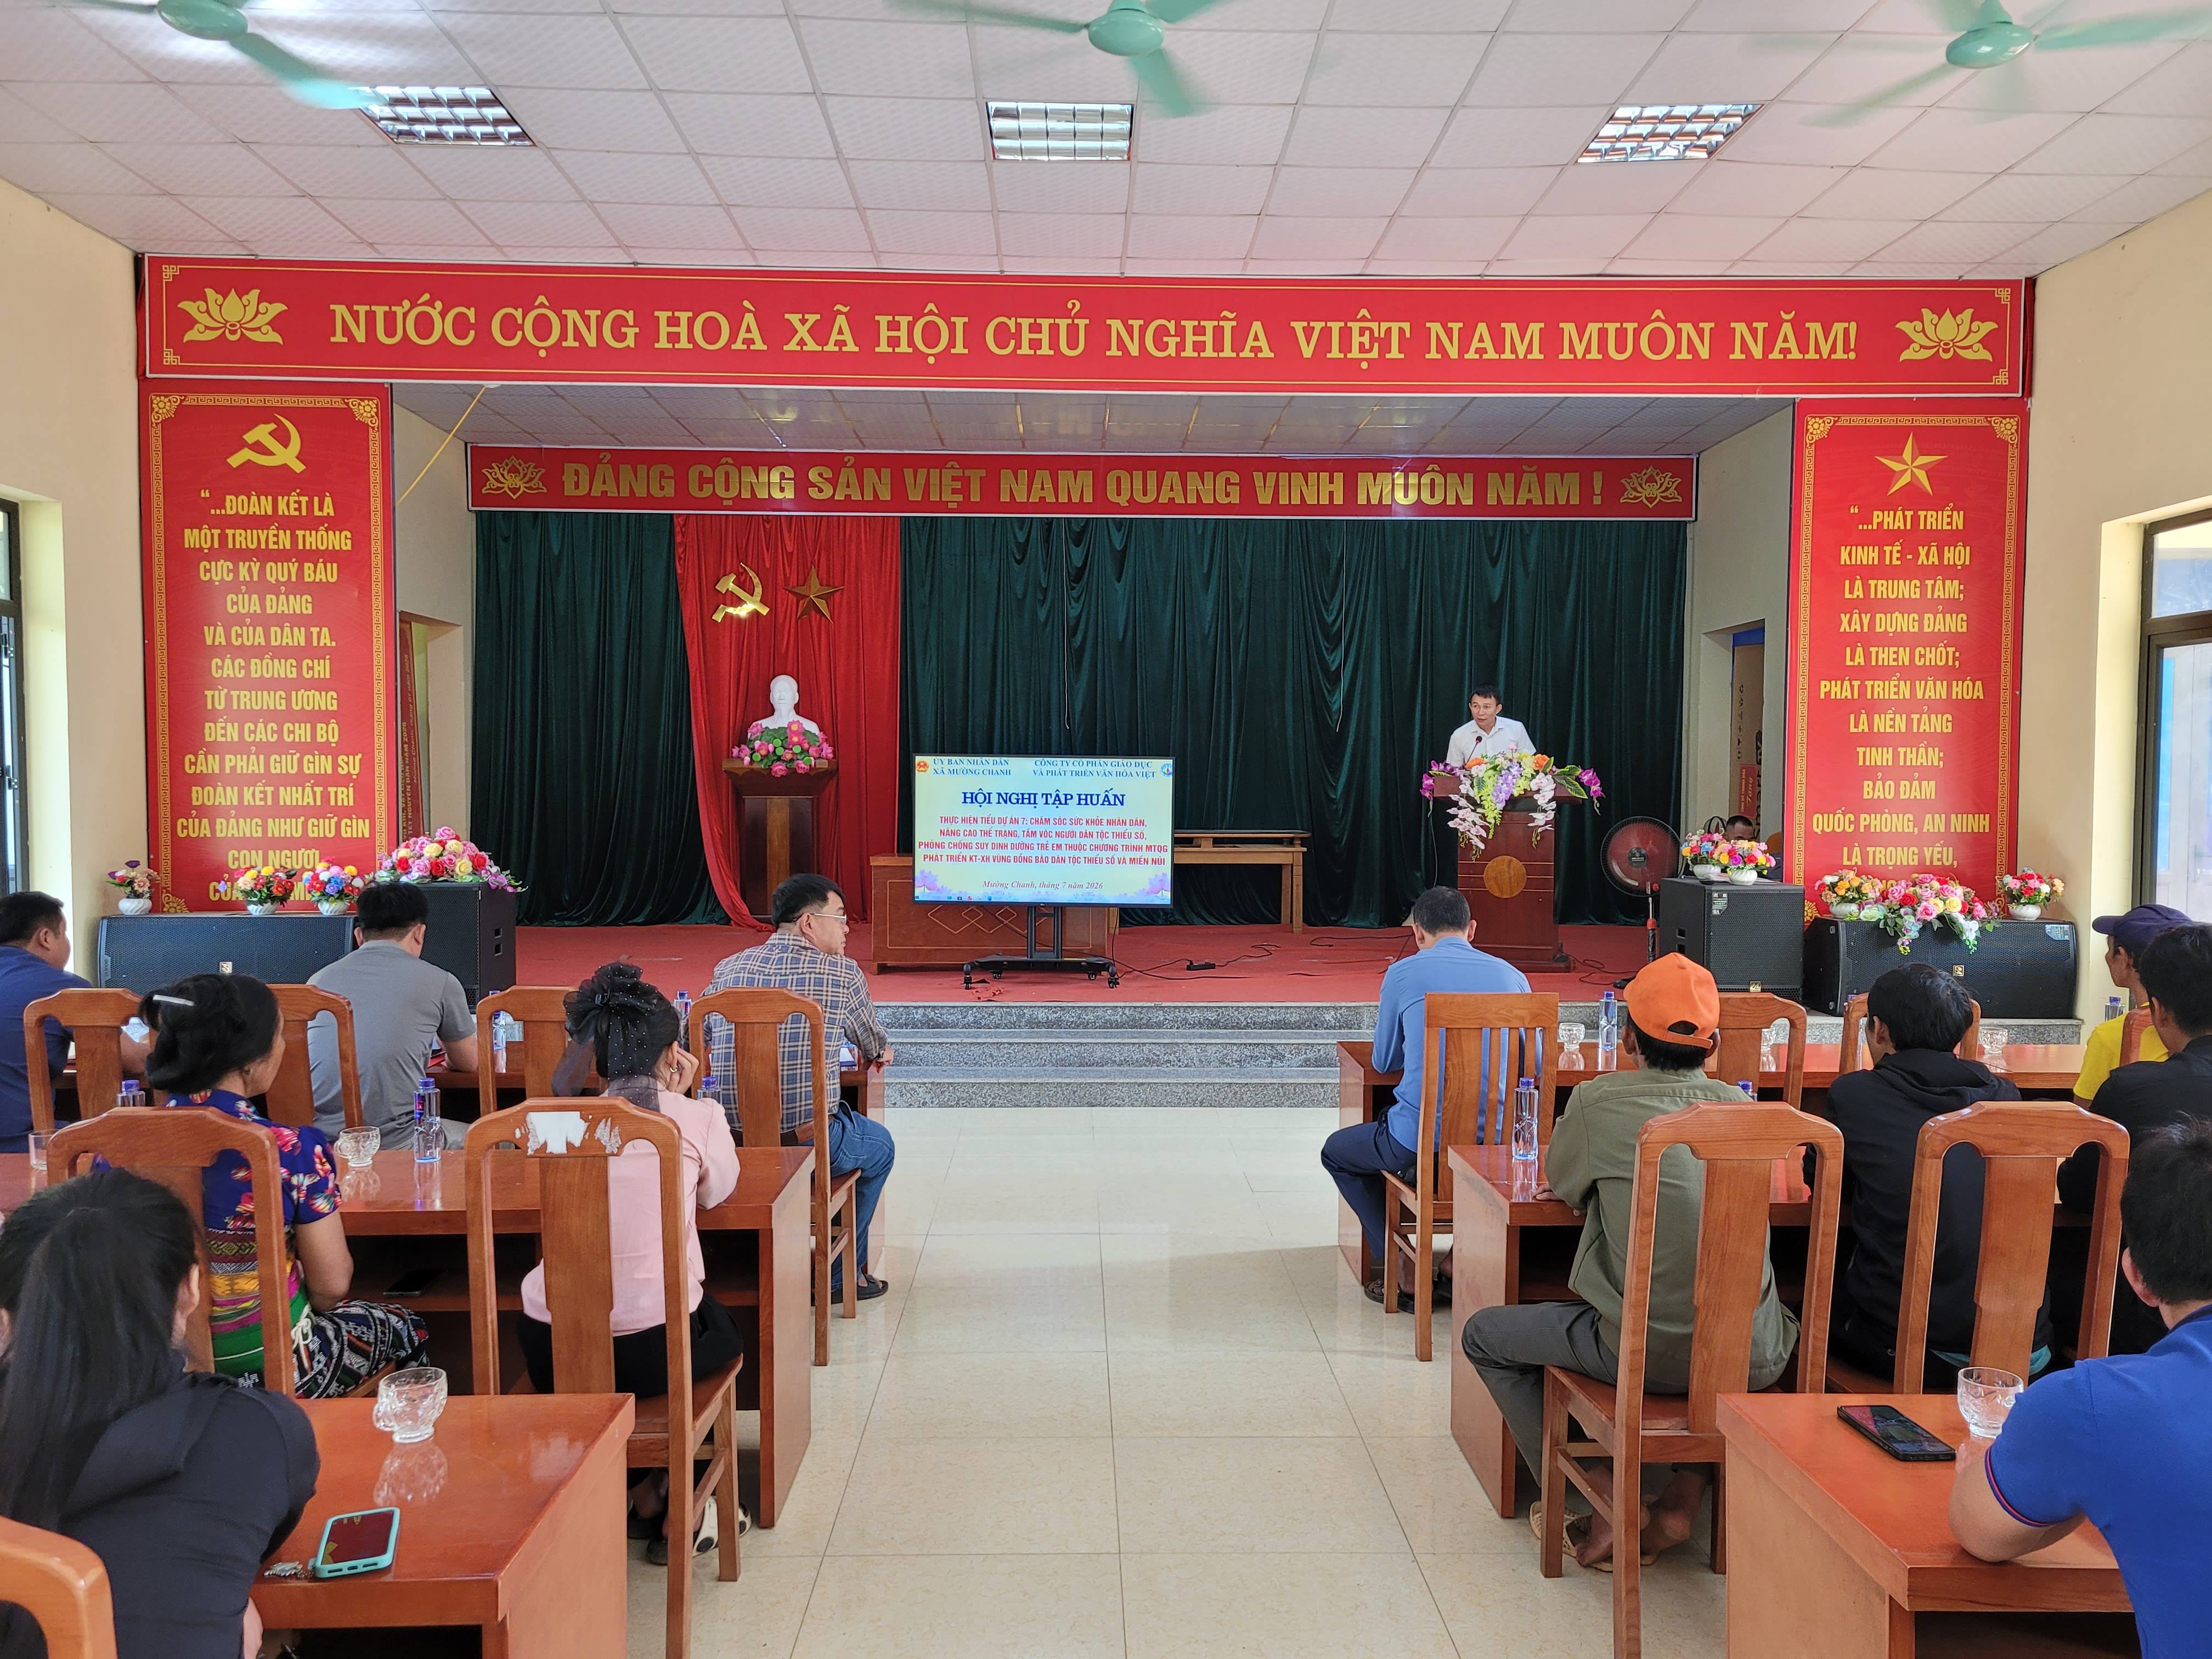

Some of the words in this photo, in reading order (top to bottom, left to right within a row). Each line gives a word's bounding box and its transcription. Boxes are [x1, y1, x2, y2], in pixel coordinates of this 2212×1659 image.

[329, 292, 476, 347] NƯỚC
[491, 295, 639, 358] CỘNG
[654, 301, 768, 352] HOÀ
[783, 302, 859, 352] XÃ
[874, 303, 969, 365] HỘI
[985, 300, 1089, 357] CHỦ
[1105, 310, 1274, 359] NGHĨA
[1290, 308, 1411, 370] VIỆT
[1425, 321, 1545, 360] NAM
[1558, 309, 1717, 361] MUÔN
[1729, 308, 1858, 361] NĂM!
[562, 452, 674, 499] ĐẢNG
[687, 456, 794, 506] CỘNG
[808, 456, 891, 501] SẢN
[903, 461, 986, 509] VIỆT
[1000, 469, 1093, 504] NAM
[1106, 469, 1242, 506] QUANG
[1253, 471, 1344, 505] VINH
[1357, 464, 1474, 506] MUÔN
[1486, 465, 1580, 506] NĂM
[1593, 472, 1603, 506] !
[278, 489, 310, 516] KẾT
[313, 492, 335, 517] LÀ
[1917, 503, 1964, 531] TRIỂN
[183, 524, 221, 553] MỘT
[225, 522, 291, 550] TRUYỀN
[296, 523, 352, 551] THỐNG
[1840, 545, 1879, 566] KINH
[1883, 539, 1904, 566] TẾ
[1917, 543, 1939, 566] XÃ
[1943, 542, 1971, 569] HỘI
[199, 560, 234, 585] CỰC
[239, 557, 262, 582] KỲ
[266, 558, 298, 584] QUÝ
[304, 558, 338, 583] BÁU
[226, 585, 261, 614] CỦA
[265, 585, 313, 615] ĐẢNG
[1844, 576, 1864, 599] LÀ
[1868, 579, 1921, 600] TRUNG
[1925, 576, 1965, 601] TÂM;
[204, 622, 226, 646] VÀ
[230, 618, 266, 646] CỦA
[270, 622, 306, 647] DÂN
[311, 626, 336, 647] TA.
[1839, 610, 1871, 633] XÂY
[1875, 611, 1919, 637] DỰNG
[1923, 605, 1968, 633] ĐẢNG
[211, 654, 245, 678] CÁC
[250, 652, 297, 679] ĐỒNG
[302, 654, 331, 679] CHÍ
[1845, 643, 1865, 666] LÀ
[1869, 646, 1910, 667] THEN
[1914, 640, 1960, 669] CHỐT;
[205, 686, 227, 710] TỪ
[230, 690, 287, 711] TRUNG
[291, 690, 338, 712] ƯƠNG
[1820, 676, 1861, 700] PHÁT
[1865, 673, 1911, 700] TRIỂN
[1915, 676, 1948, 700] VĂN
[1951, 678, 1984, 700] HÓA
[204, 715, 239, 742] ĐẾN
[243, 718, 278, 743] CÁC
[283, 721, 312, 743] CHI
[316, 719, 339, 747] BỘ
[1849, 710, 1869, 733] LÀ
[1873, 707, 1906, 733] NỀN
[1911, 706, 1953, 733] TẢNG
[184, 747, 220, 775] CẦN
[225, 746, 264, 774] PHẢI
[269, 750, 300, 775] GIỮ
[303, 751, 333, 775] GÌN
[337, 753, 363, 778] SỰ
[992, 758, 1009, 766] DÂN
[1035, 758, 1058, 766] CÔNG
[1110, 759, 1132, 768] GIÁO
[1135, 761, 1153, 769] DỤC
[1857, 747, 1893, 766] TINH
[1897, 741, 1944, 769] THẦN;
[191, 782, 238, 806] ĐOÀN
[243, 779, 274, 806] KẾT
[279, 780, 323, 807] NHẤT
[328, 783, 354, 806] TRÍ
[962, 788, 992, 808] HỘI
[996, 792, 1039, 809] NGHỊ
[1041, 789, 1073, 809] TẬP
[1076, 787, 1126, 806] HUẤN
[1863, 772, 1895, 800] BẢO
[1899, 772, 1936, 800] ĐẢM
[176, 810, 211, 838] CỦA
[216, 810, 262, 838] ĐẢNG
[267, 816, 305, 838] NHƯ
[307, 814, 338, 838] GIỮ
[340, 814, 370, 838] GÌN
[939, 816, 959, 826] THỰC
[961, 815, 978, 826] HIỆN
[998, 816, 1008, 826] DỰ
[1009, 816, 1019, 825] ÁN
[1053, 816, 1067, 826] SÓC
[1069, 816, 1084, 826] SỨC
[1106, 817, 1127, 827] NHÂN
[1129, 817, 1147, 828] DÂN,
[940, 827, 961, 837] NÂNG
[963, 829, 977, 837] CAO
[995, 829, 1020, 839] TRẠNG,
[1079, 830, 1093, 839] DÂN
[1134, 829, 1147, 840] SỐ,
[1812, 806, 1855, 834] QUỐC
[1859, 809, 1918, 835] PHÒNG,
[1922, 813, 1946, 833] AN
[1950, 814, 1990, 833] NINH
[227, 849, 263, 869] CON
[923, 853, 944, 862] PHÁT
[969, 855, 990, 863] KT-XH
[992, 854, 1011, 863] VÙNG
[1051, 856, 1066, 864] DÂN
[1105, 854, 1115, 865] SỐ
[1151, 856, 1166, 865] NÚI
[1121, 843, 1143, 853] TRÌNH
[1146, 845, 1168, 854] MTQG
[1842, 843, 1862, 866] LÀ
[1866, 847, 1918, 870] TRỌNG
[1923, 840, 1958, 868] YẾU,
[1011, 880, 1037, 889] Chanh,
[1039, 881, 1060, 890] tháng
